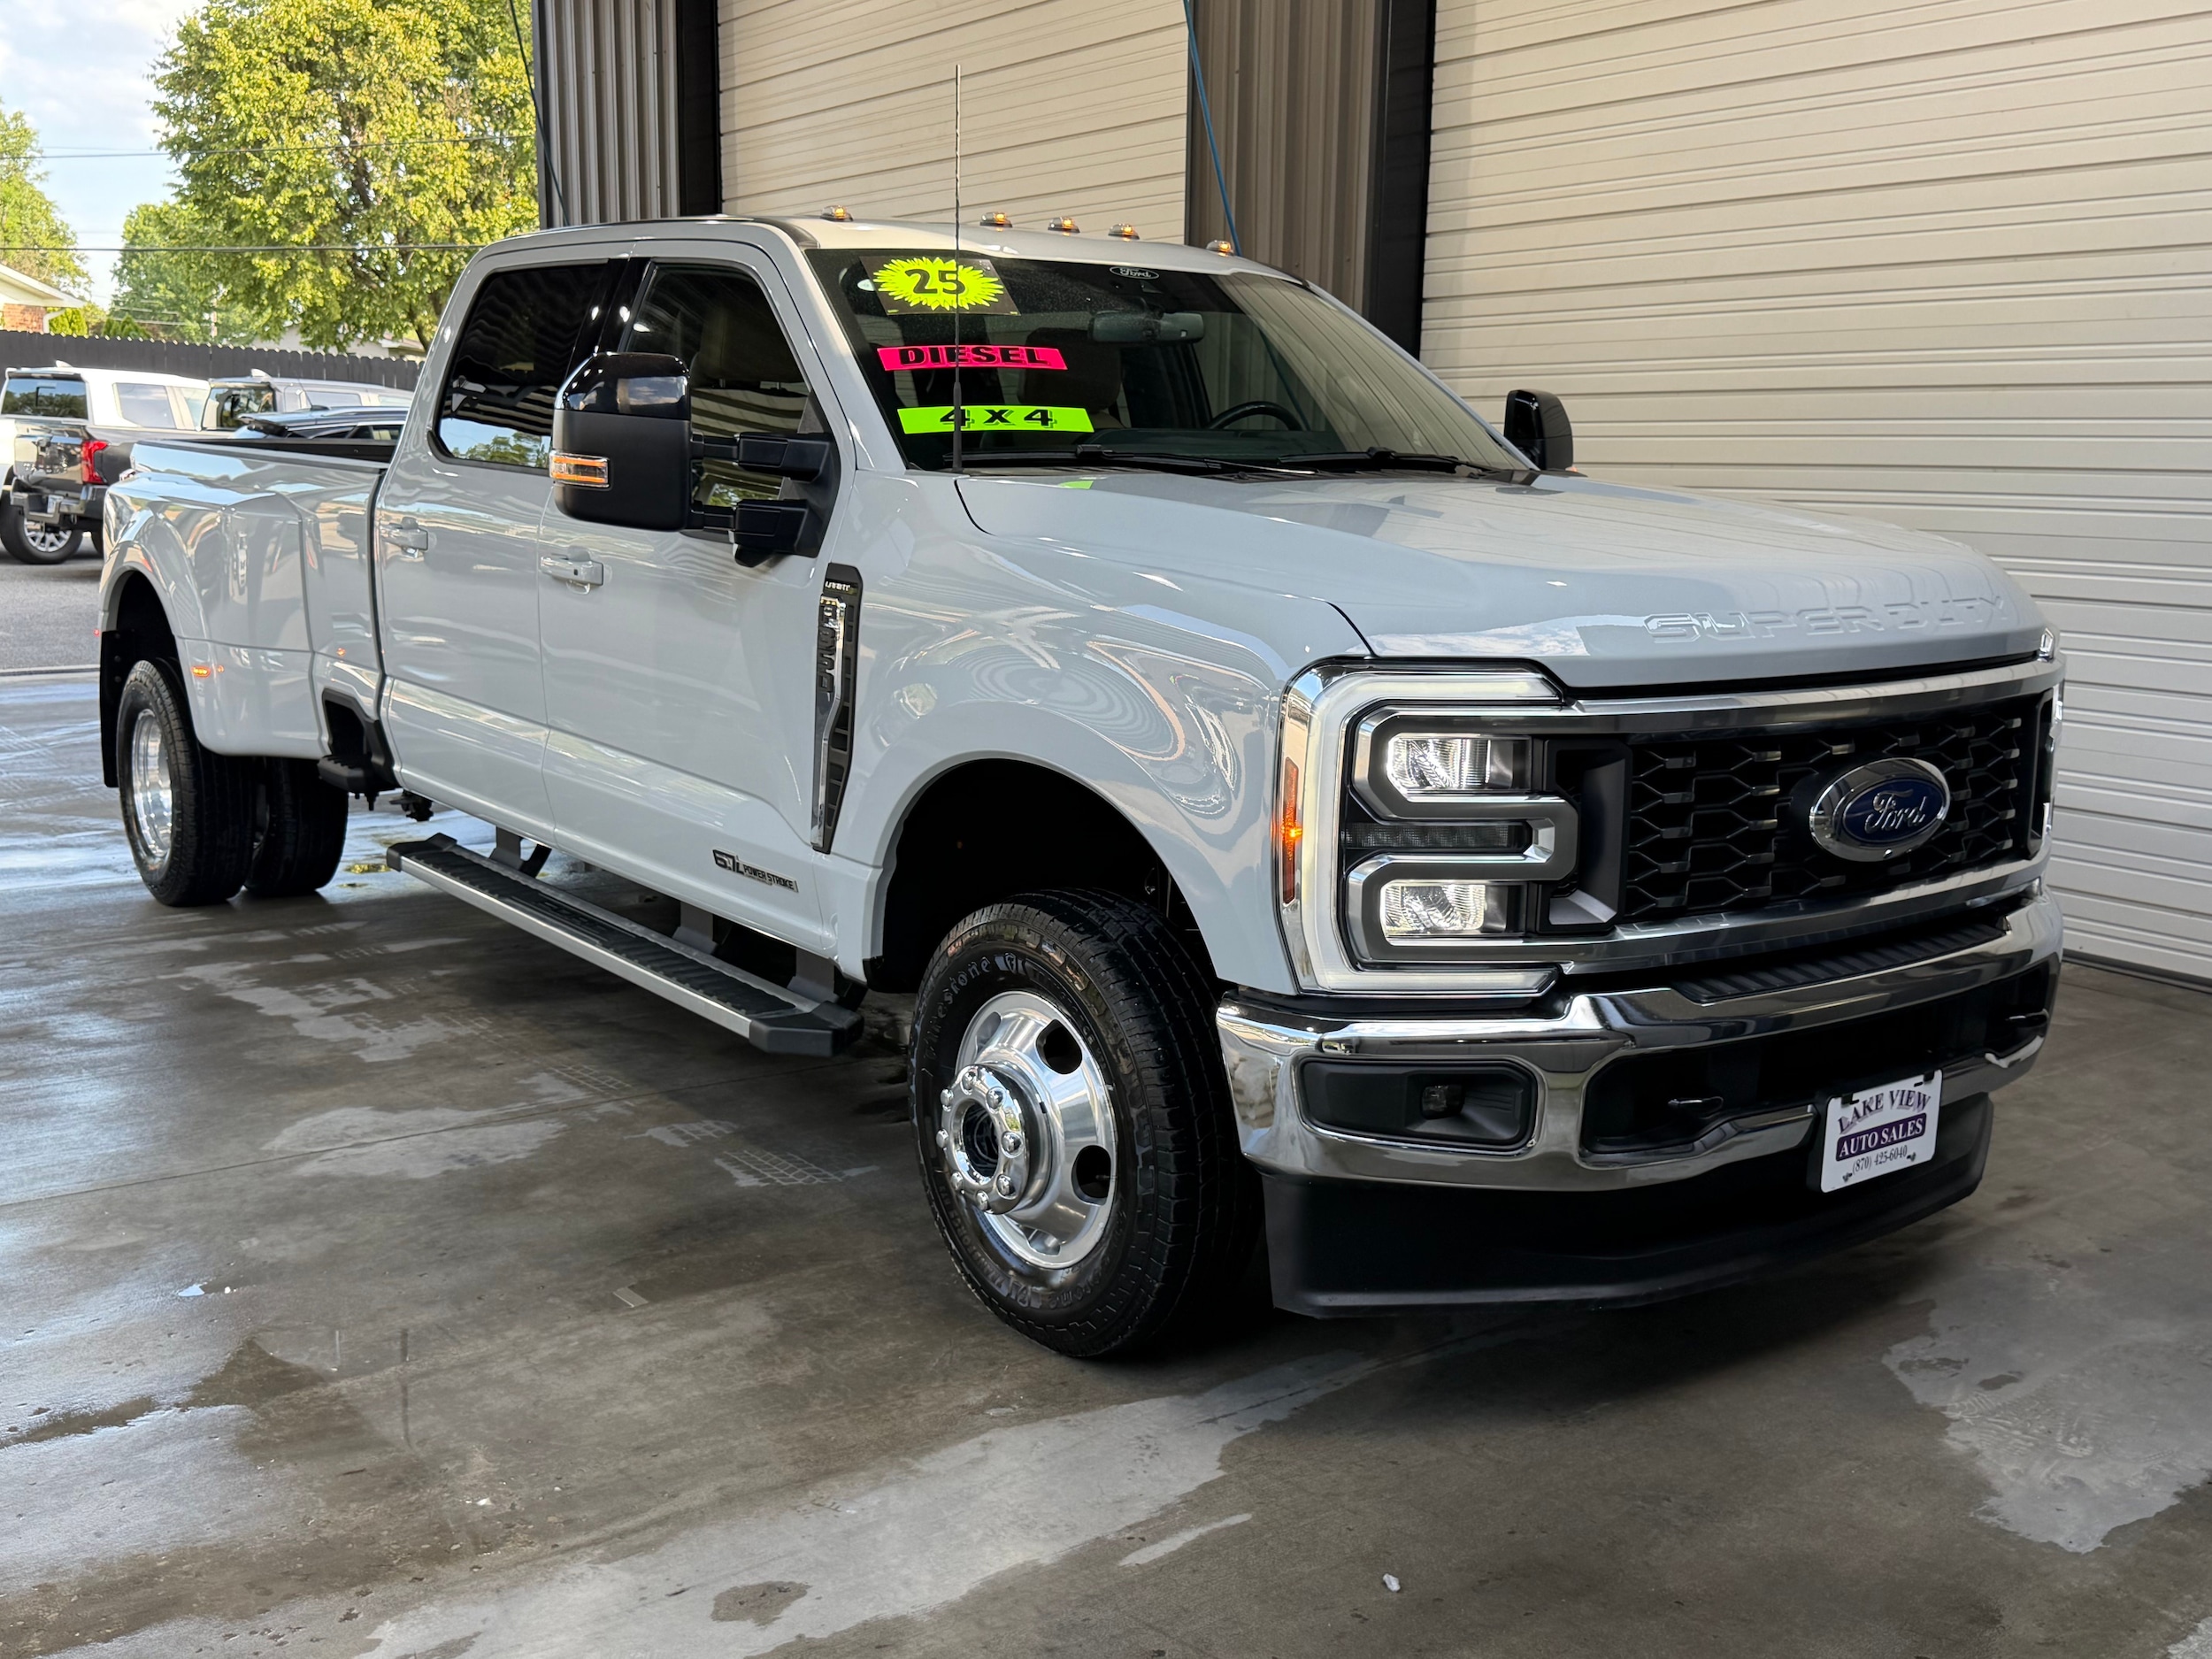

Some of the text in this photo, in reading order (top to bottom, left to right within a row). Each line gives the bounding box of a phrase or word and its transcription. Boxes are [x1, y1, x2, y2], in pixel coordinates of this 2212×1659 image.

[905, 268, 966, 295] 25
[1119, 267, 1151, 278] Ford
[899, 346, 1049, 365] DIESEL
[1642, 605, 1885, 643] SUPER
[1864, 788, 1926, 834] Ford
[743, 864, 767, 881] POWER
[766, 872, 795, 891] STROKE
[1838, 1089, 1931, 1134] LAKE VIEW
[1839, 1118, 1924, 1157] AUTO SALES
[1852, 1144, 1908, 1175] (870) 425-6040
